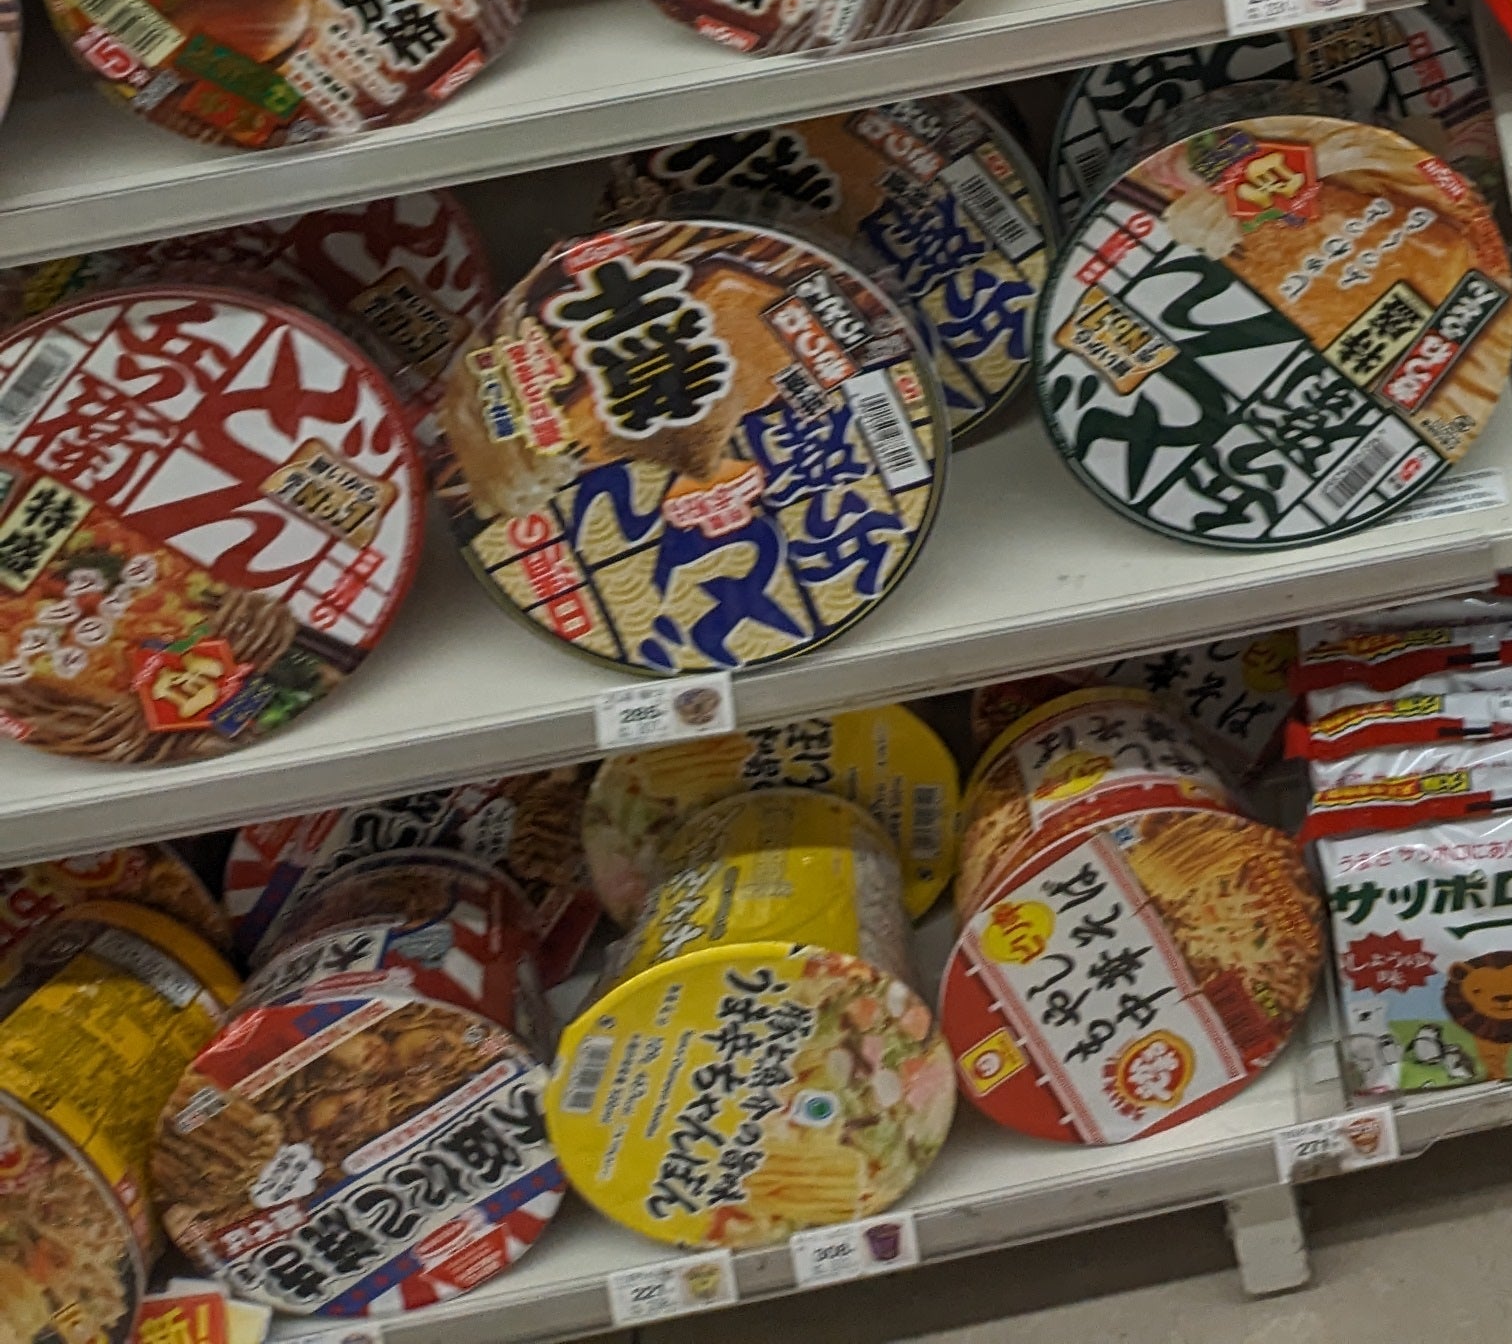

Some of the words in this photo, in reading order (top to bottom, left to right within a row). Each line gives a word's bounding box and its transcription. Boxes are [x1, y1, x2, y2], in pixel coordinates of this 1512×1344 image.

[1074, 212, 1156, 287] 日清の
[546, 259, 730, 436] 煮干
[774, 300, 855, 389] きつね
[800, 272, 870, 347] うどん
[1336, 295, 1421, 383] 特盛
[1440, 277, 1497, 338] うどん
[20, 299, 234, 504] 兵衛
[1051, 253, 1303, 504] どん
[1187, 359, 1373, 537] 兵衛
[1383, 336, 1456, 408] きつね
[121, 323, 362, 594] どん
[0, 483, 82, 582] 特盛
[506, 513, 594, 642] 日清の
[574, 459, 815, 671] どん
[743, 403, 915, 600] 兵衛
[981, 900, 1047, 960] ピリ辛
[1045, 862, 1182, 1038] 中華そば
[1024, 952, 1108, 1064] もやし
